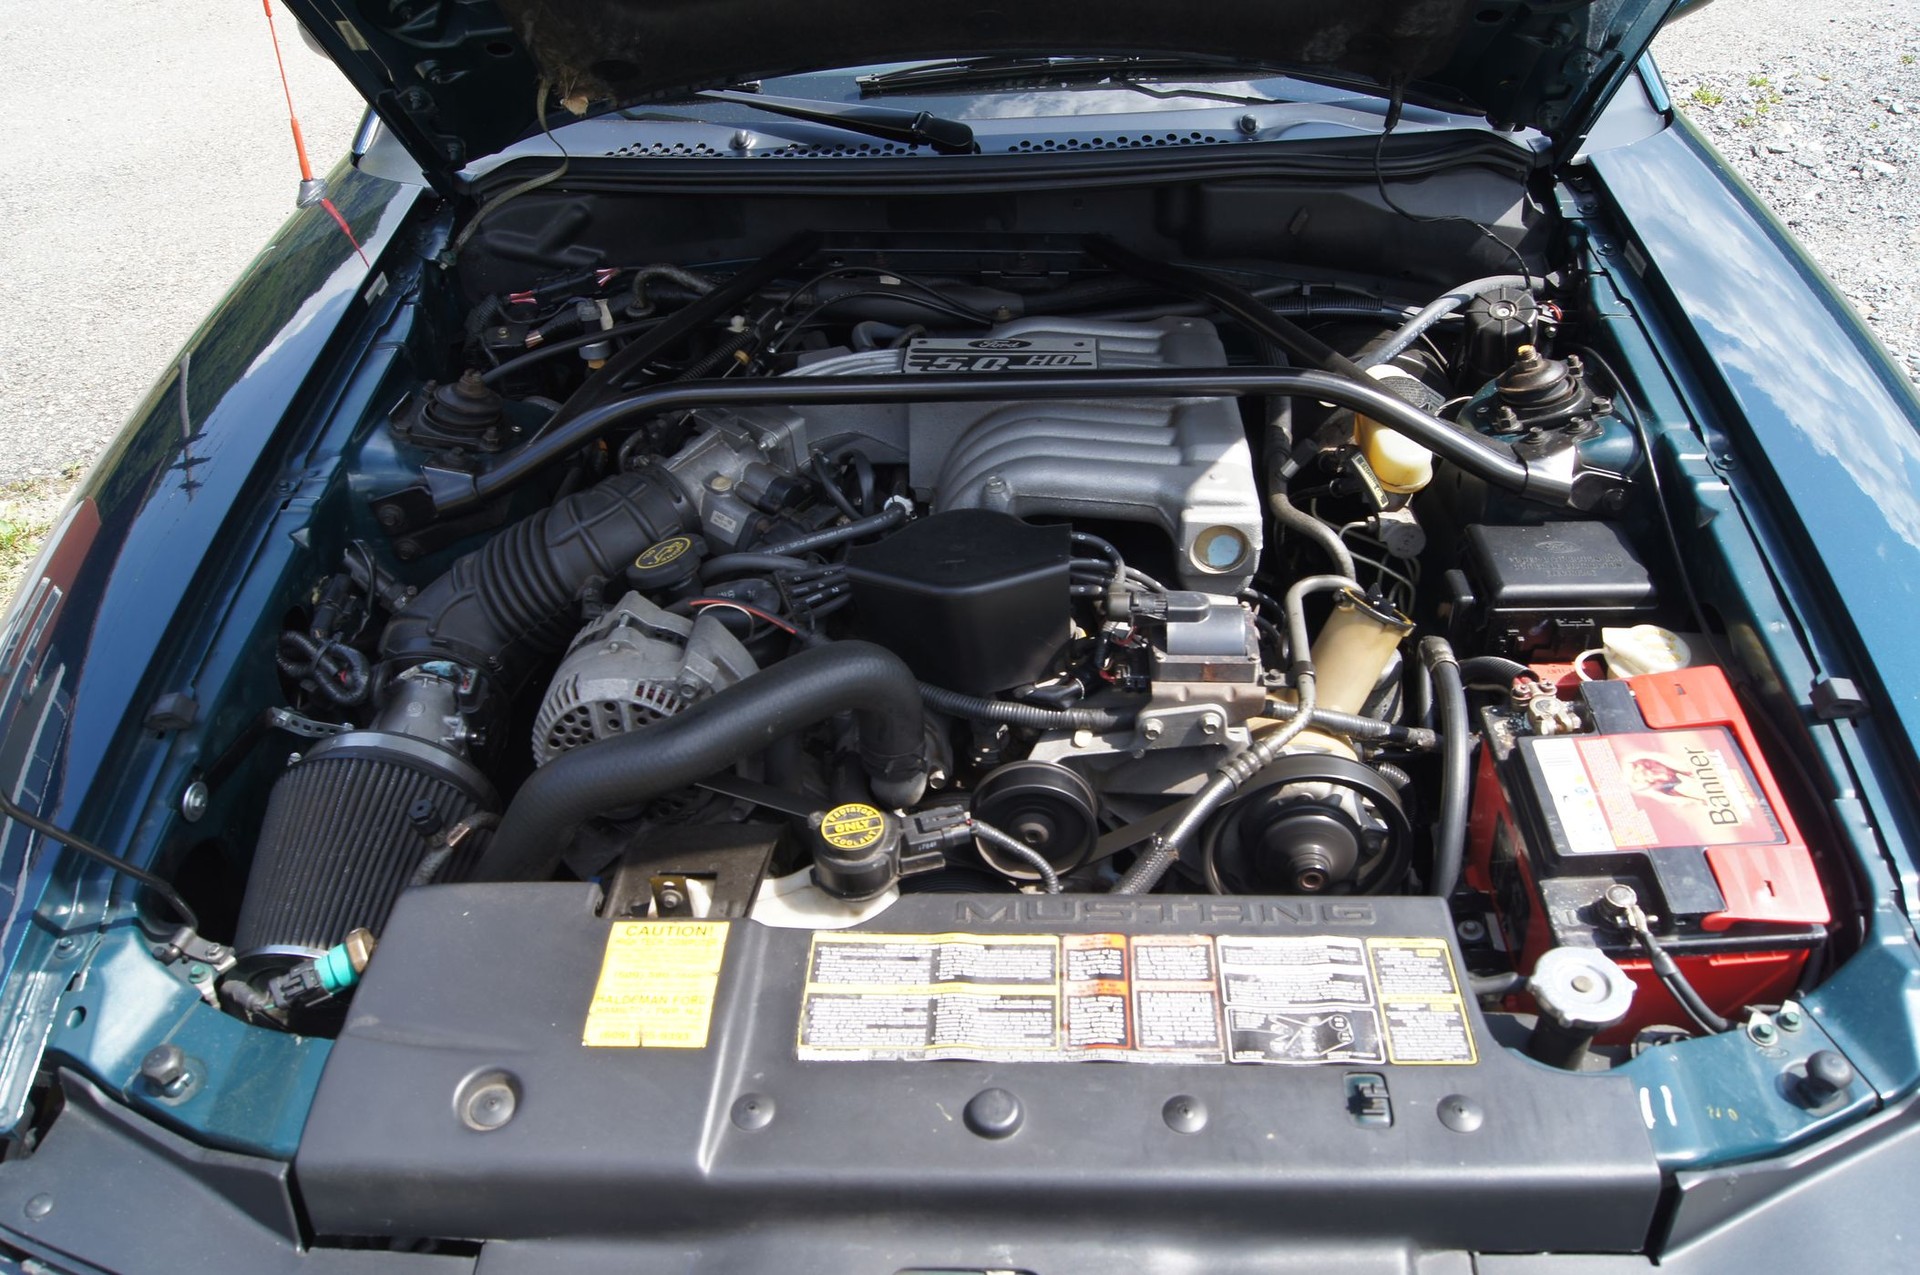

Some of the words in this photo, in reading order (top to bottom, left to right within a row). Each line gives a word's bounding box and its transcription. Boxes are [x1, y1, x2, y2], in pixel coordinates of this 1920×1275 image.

[978, 340, 1020, 349] Ford
[927, 356, 1010, 372] 5.0
[1027, 355, 1077, 366] HO
[1684, 747, 1739, 825] Banner
[828, 806, 874, 823] RADIATOR
[834, 819, 870, 834] ONLY
[833, 830, 877, 846] COOLANT
[955, 900, 1377, 926] MUSTANG
[626, 926, 714, 937] CAUTION!
